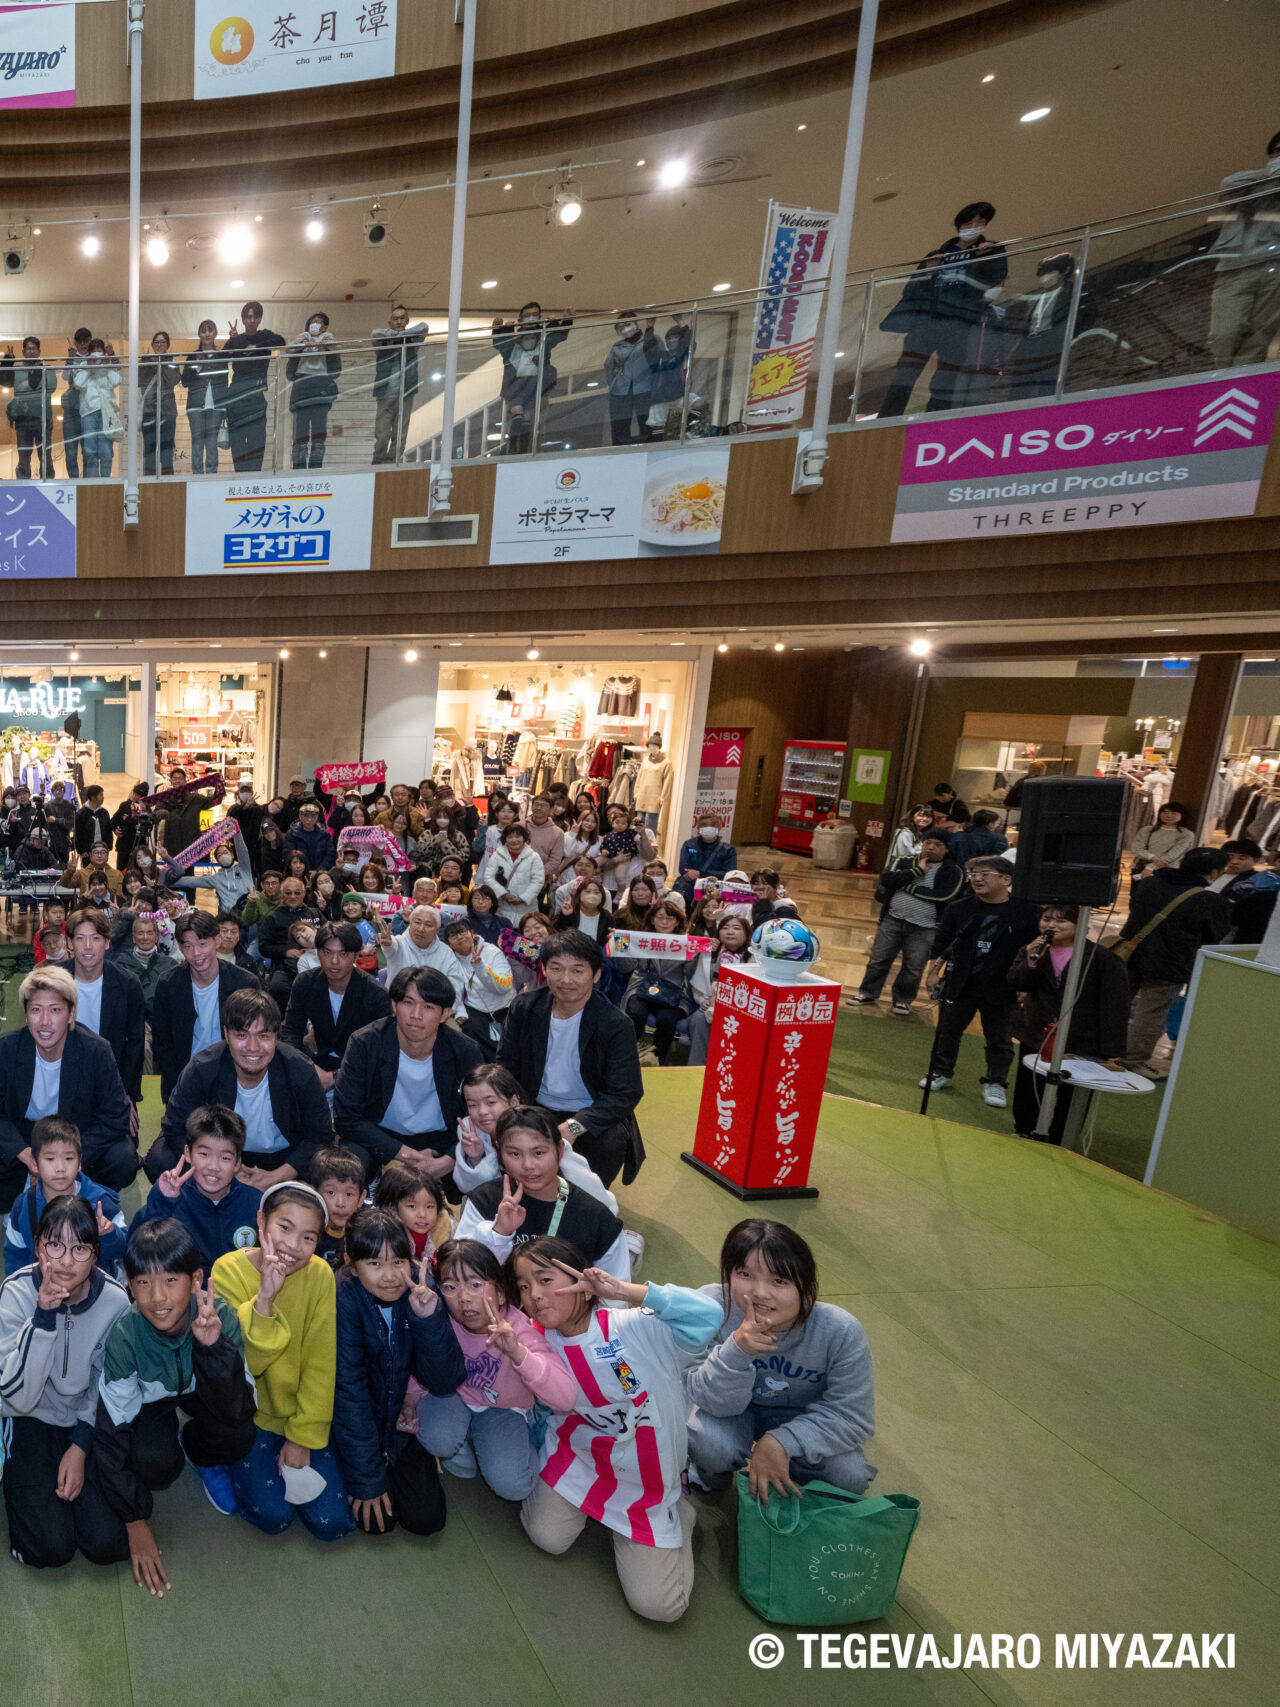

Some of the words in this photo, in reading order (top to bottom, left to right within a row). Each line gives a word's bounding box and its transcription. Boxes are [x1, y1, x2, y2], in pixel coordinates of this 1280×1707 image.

[295, 57, 310, 65] cha
[318, 54, 332, 63] yue
[779, 212, 830, 229] Welcome
[1102, 426, 1184, 445] ダイソー
[915, 424, 1095, 467] DAISO
[947, 476, 1057, 503] Standard
[1063, 465, 1190, 492] Products
[55, 489, 74, 505] 2F
[232, 504, 325, 529] メガネの
[518, 506, 615, 527] ポポラマーマ
[973, 500, 1147, 529] THREEPPY
[230, 534, 324, 560] ヨネザワ
[553, 546, 570, 557] 2F
[711, 807, 733, 815] SHOP
[821, 1543, 878, 1560] CLOTHES
[831, 1570, 865, 1579] COHINA
[817, 1586, 837, 1603] ON
